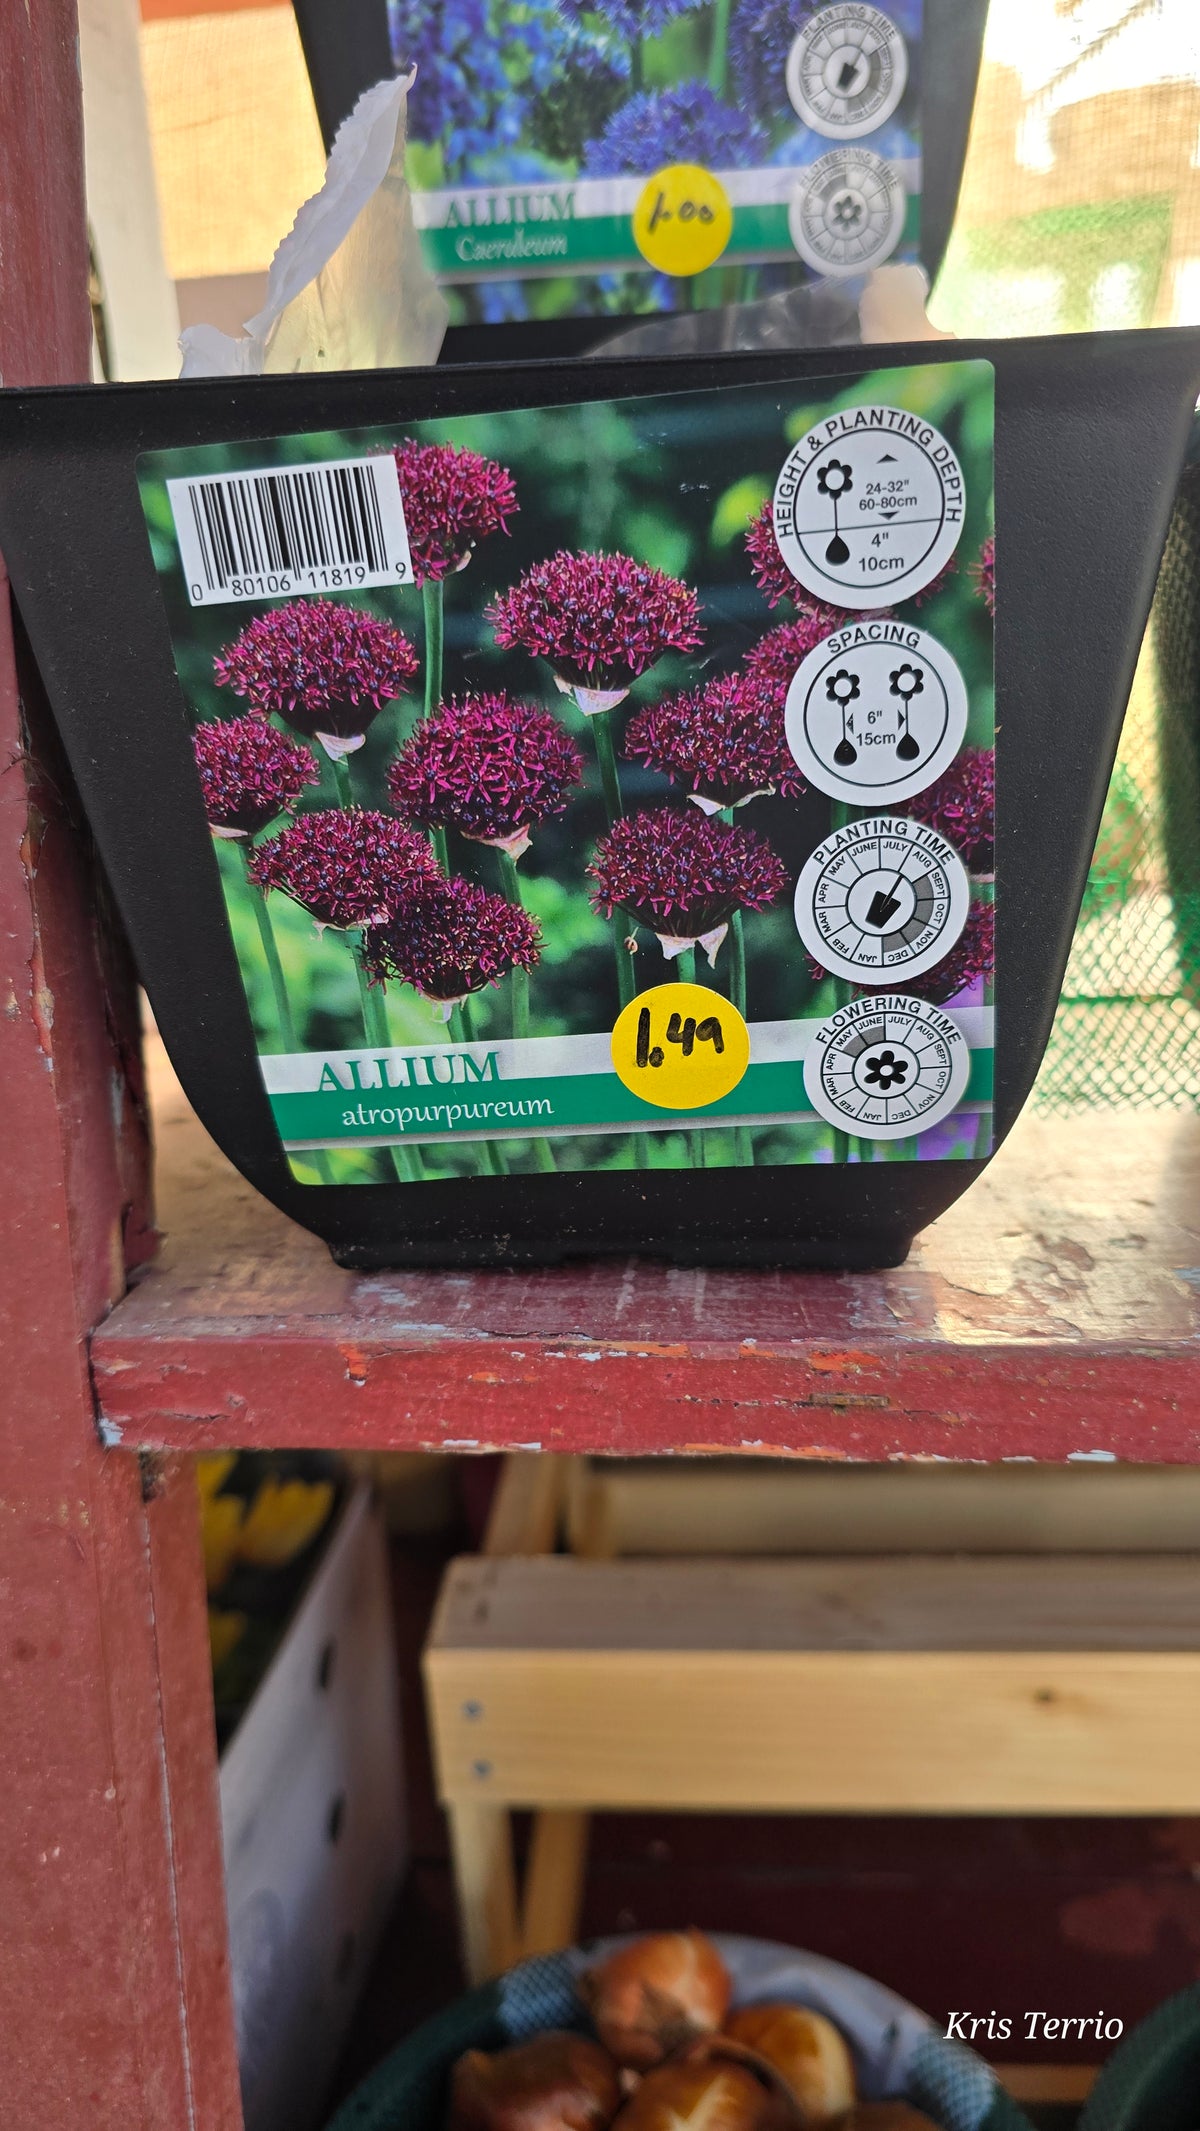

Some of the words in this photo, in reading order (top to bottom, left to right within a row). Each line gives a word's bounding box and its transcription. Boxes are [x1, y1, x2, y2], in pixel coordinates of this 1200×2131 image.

[445, 191, 577, 227] ALLIUM
[776, 450, 807, 538] HEIGHT
[807, 435, 824, 451] &
[825, 409, 935, 447] PLANTING
[932, 445, 962, 523] DEPTH
[865, 480, 910, 495] 24-32"
[859, 496, 918, 510] 60-80cm
[871, 532, 889, 548] 4"
[858, 556, 904, 572] 10cm
[191, 584, 203, 600] 0
[232, 574, 291, 597] 80106
[307, 566, 366, 588] 11819
[395, 562, 407, 579] 9
[827, 624, 921, 654] SPACING
[867, 710, 882, 725] 6"
[856, 732, 896, 747] 15cm
[812, 819, 908, 865] PLANTING
[915, 826, 956, 866] TIME
[851, 841, 877, 857] JUNE
[883, 841, 908, 852] JULY
[828, 855, 847, 876] MAY
[912, 850, 932, 868] AUG
[931, 871, 945, 896] SEPT
[818, 883, 830, 903] APR
[818, 911, 832, 933] MAR
[933, 903, 945, 924] OCT
[832, 938, 850, 954] FEB
[915, 930, 934, 949] NOV
[857, 953, 877, 963] JAN
[887, 949, 909, 962] DEC
[815, 997, 921, 1045] FLOWERING
[925, 1007, 962, 1045] TIME
[858, 1016, 883, 1030] JUNE
[888, 1016, 912, 1026] JULY
[634, 1007, 725, 1068] 1.49
[836, 1029, 853, 1047] MAY
[915, 1024, 934, 1041] AUG
[826, 1052, 837, 1071] APR
[934, 1043, 947, 1065] SEPT
[316, 1050, 501, 1093] ALLIUM
[936, 1071, 947, 1089] OCT
[825, 1077, 839, 1096] MAR
[839, 1099, 856, 1113] FEB
[918, 1094, 936, 1110] NOV
[341, 1098, 555, 1130] atropurpureum
[863, 1112, 882, 1120] JAN
[891, 1109, 911, 1120] DEC
